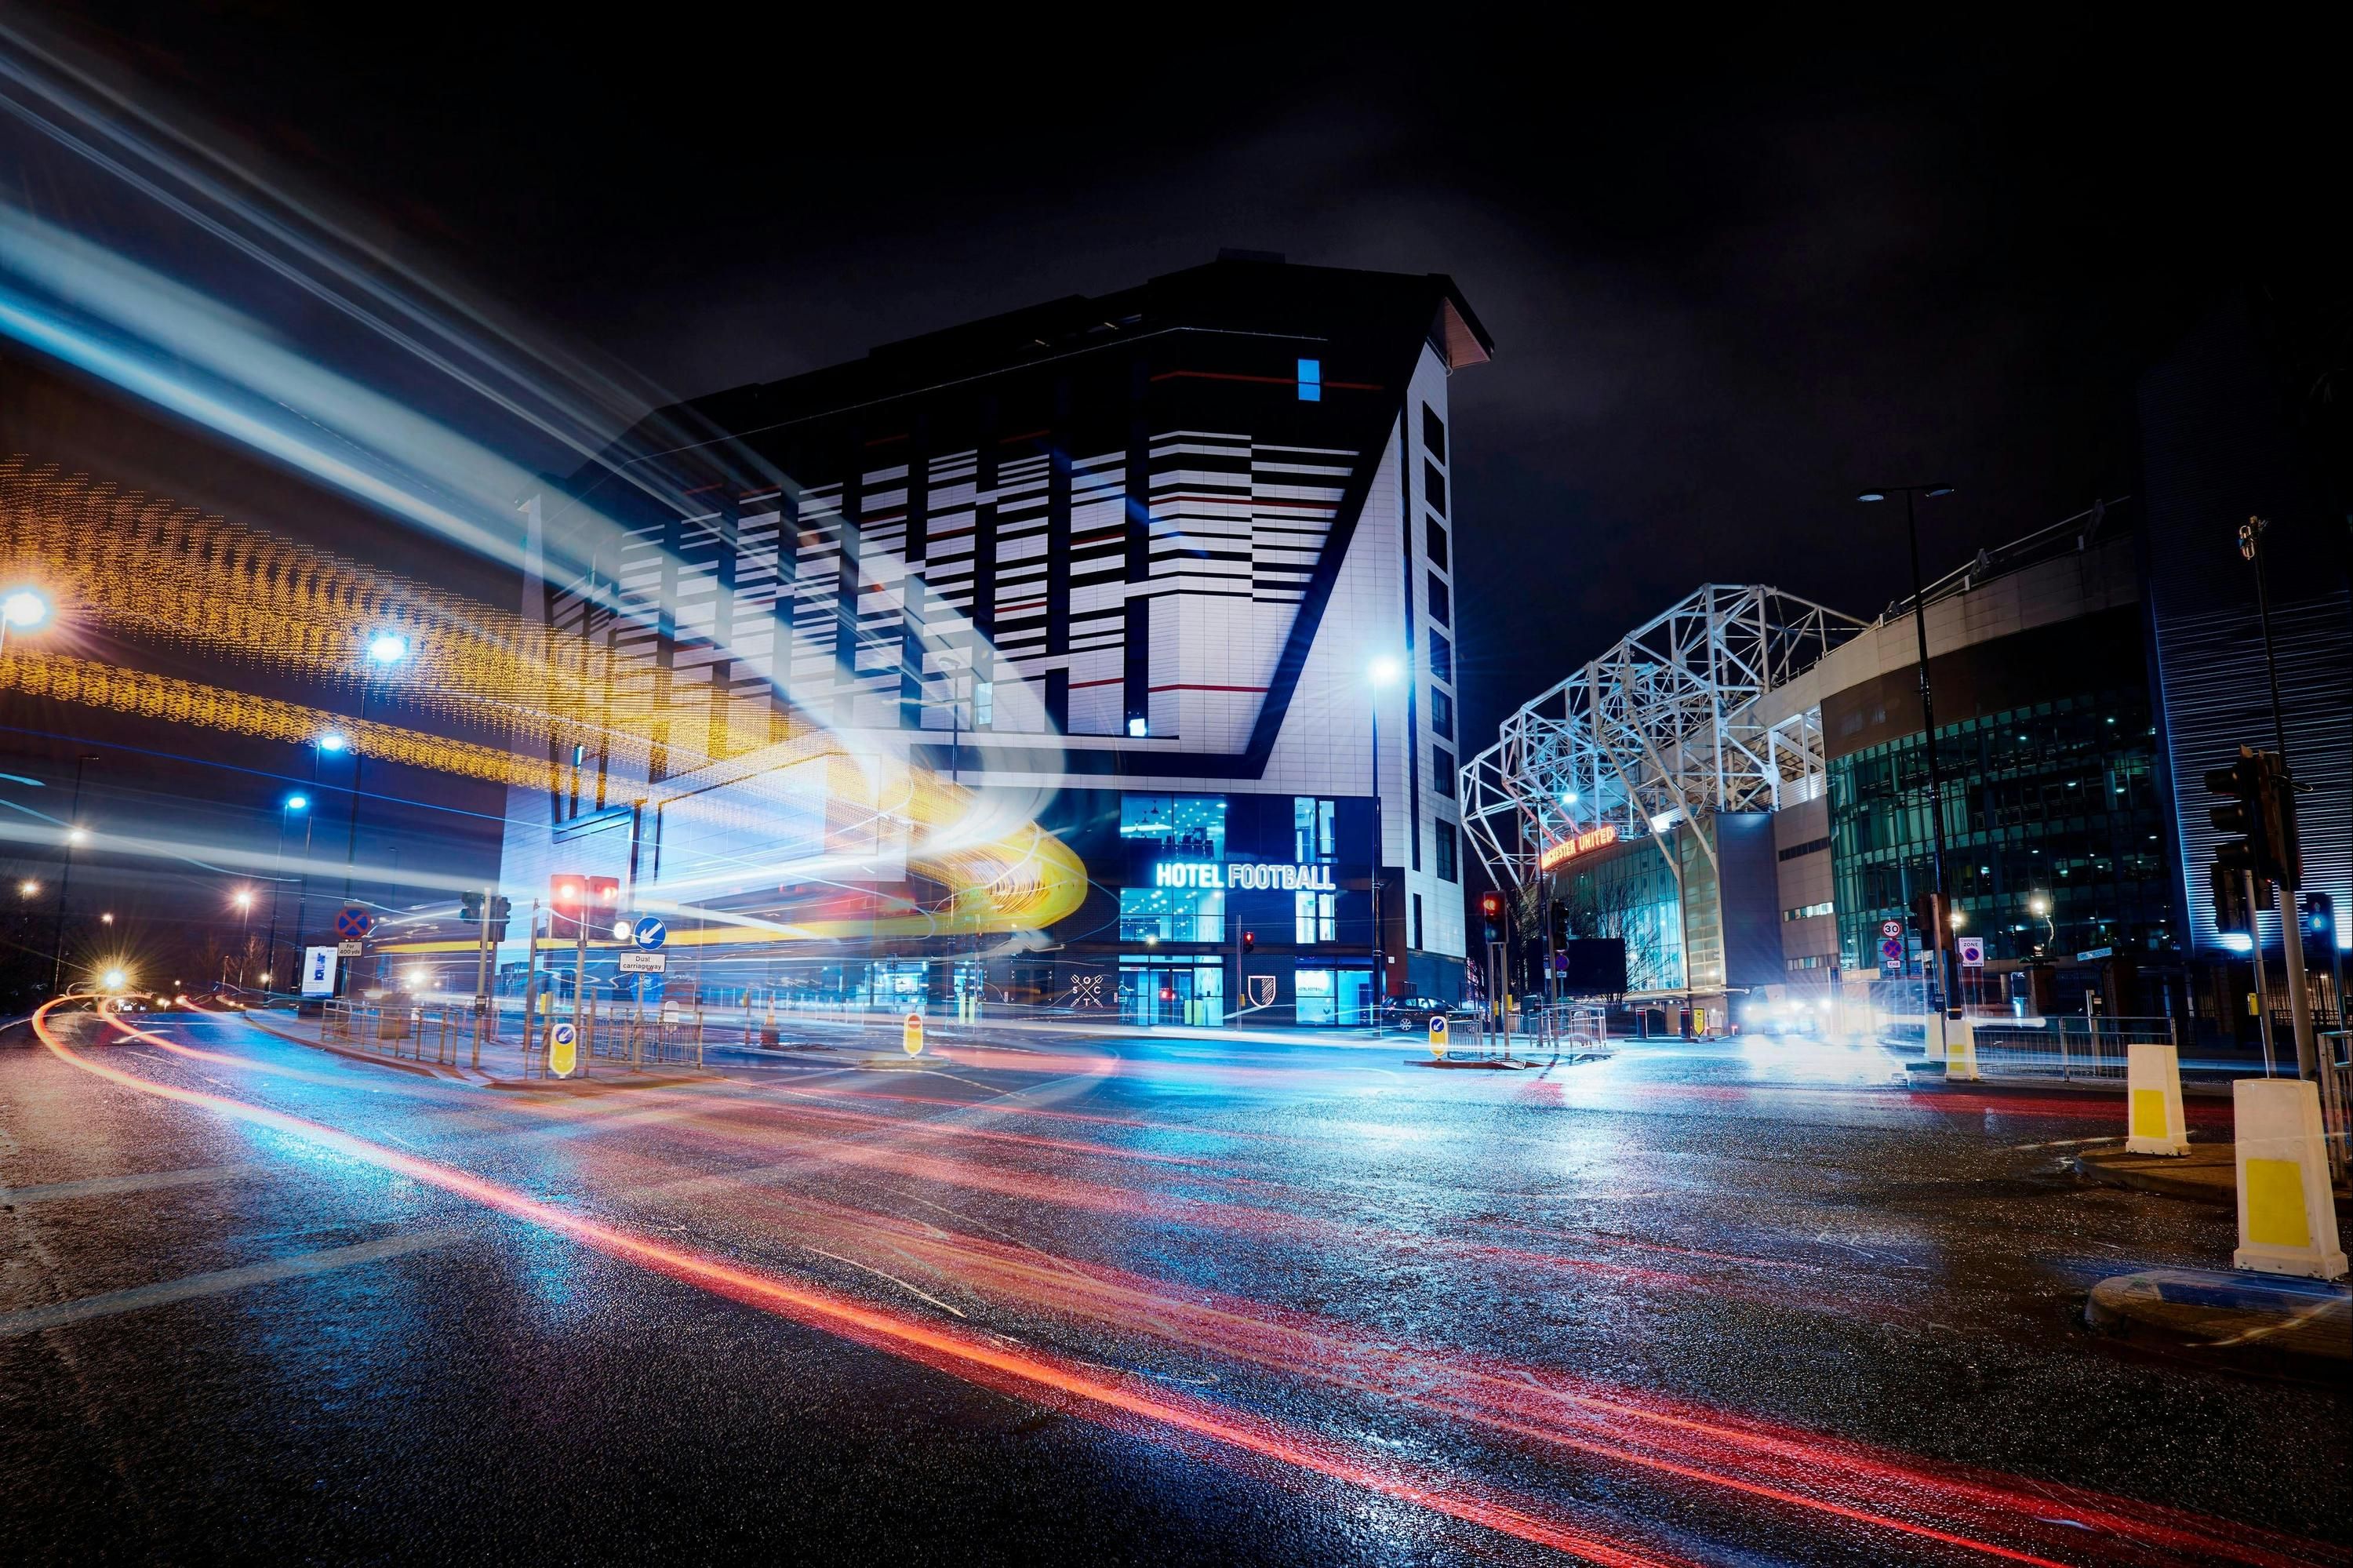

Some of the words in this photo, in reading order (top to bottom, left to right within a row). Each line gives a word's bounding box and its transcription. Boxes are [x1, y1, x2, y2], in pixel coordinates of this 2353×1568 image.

[1541, 839, 1577, 869] NCHESTER
[1579, 826, 1614, 850] UNITED
[1156, 862, 1225, 888] HOTEL
[1227, 864, 1337, 890] FOOTBALL
